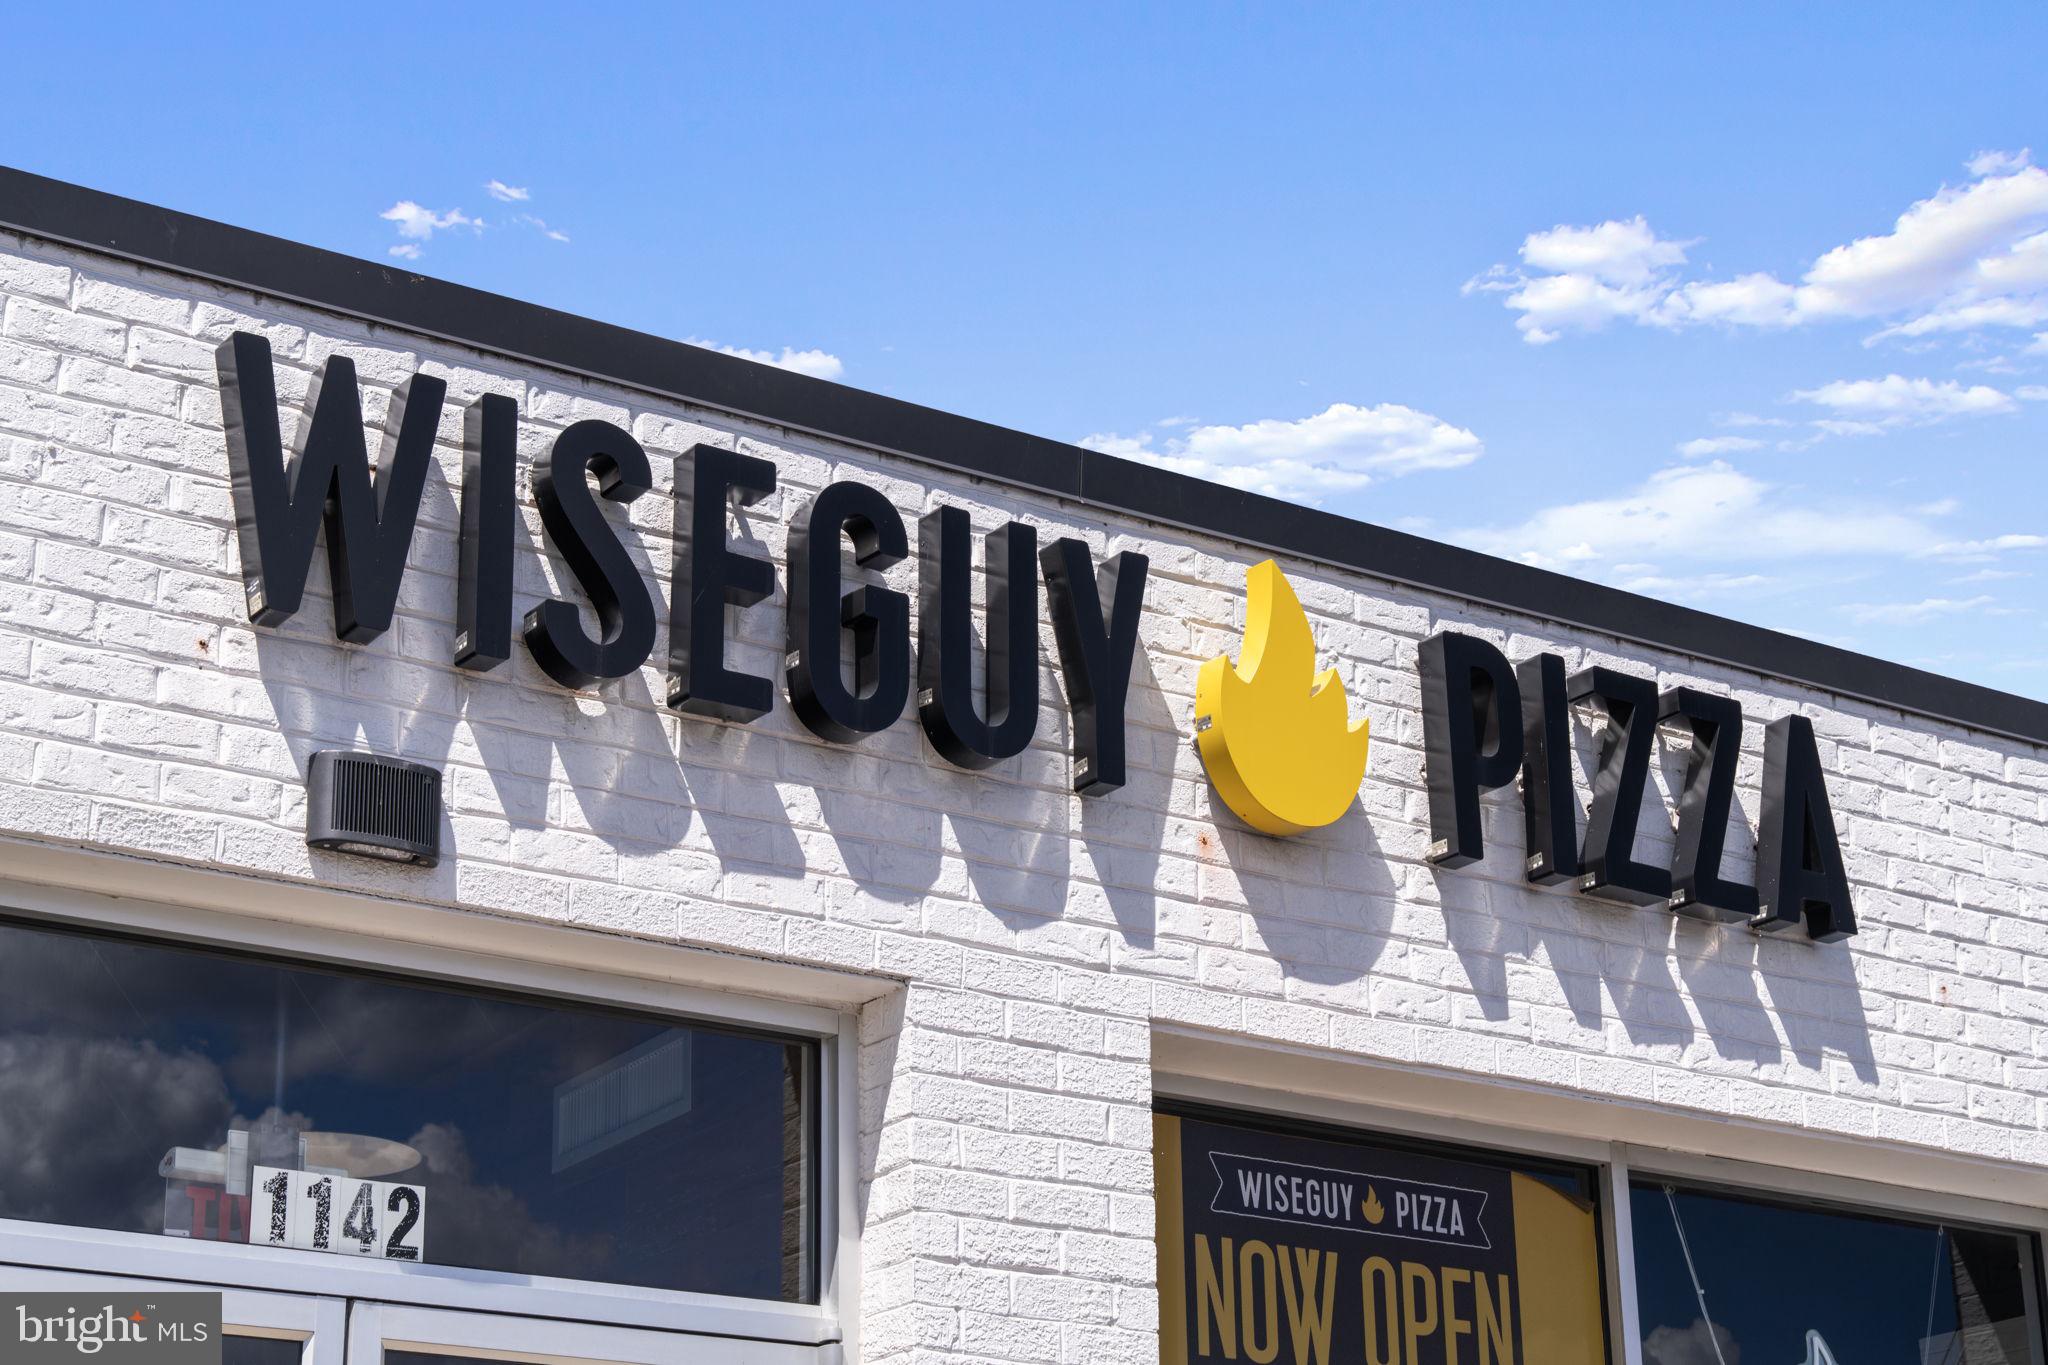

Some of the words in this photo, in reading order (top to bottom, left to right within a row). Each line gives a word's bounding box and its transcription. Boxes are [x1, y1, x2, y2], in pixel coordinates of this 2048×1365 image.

[215, 331, 1149, 797] WISEGUY
[1418, 631, 1858, 944] PIZZA
[262, 1170, 421, 1260] 1142
[1237, 1168, 1354, 1221] WISEGUY
[1395, 1191, 1466, 1237] PIZZA
[1194, 1233, 1338, 1365] NOW
[1361, 1255, 1514, 1365] OPEN
